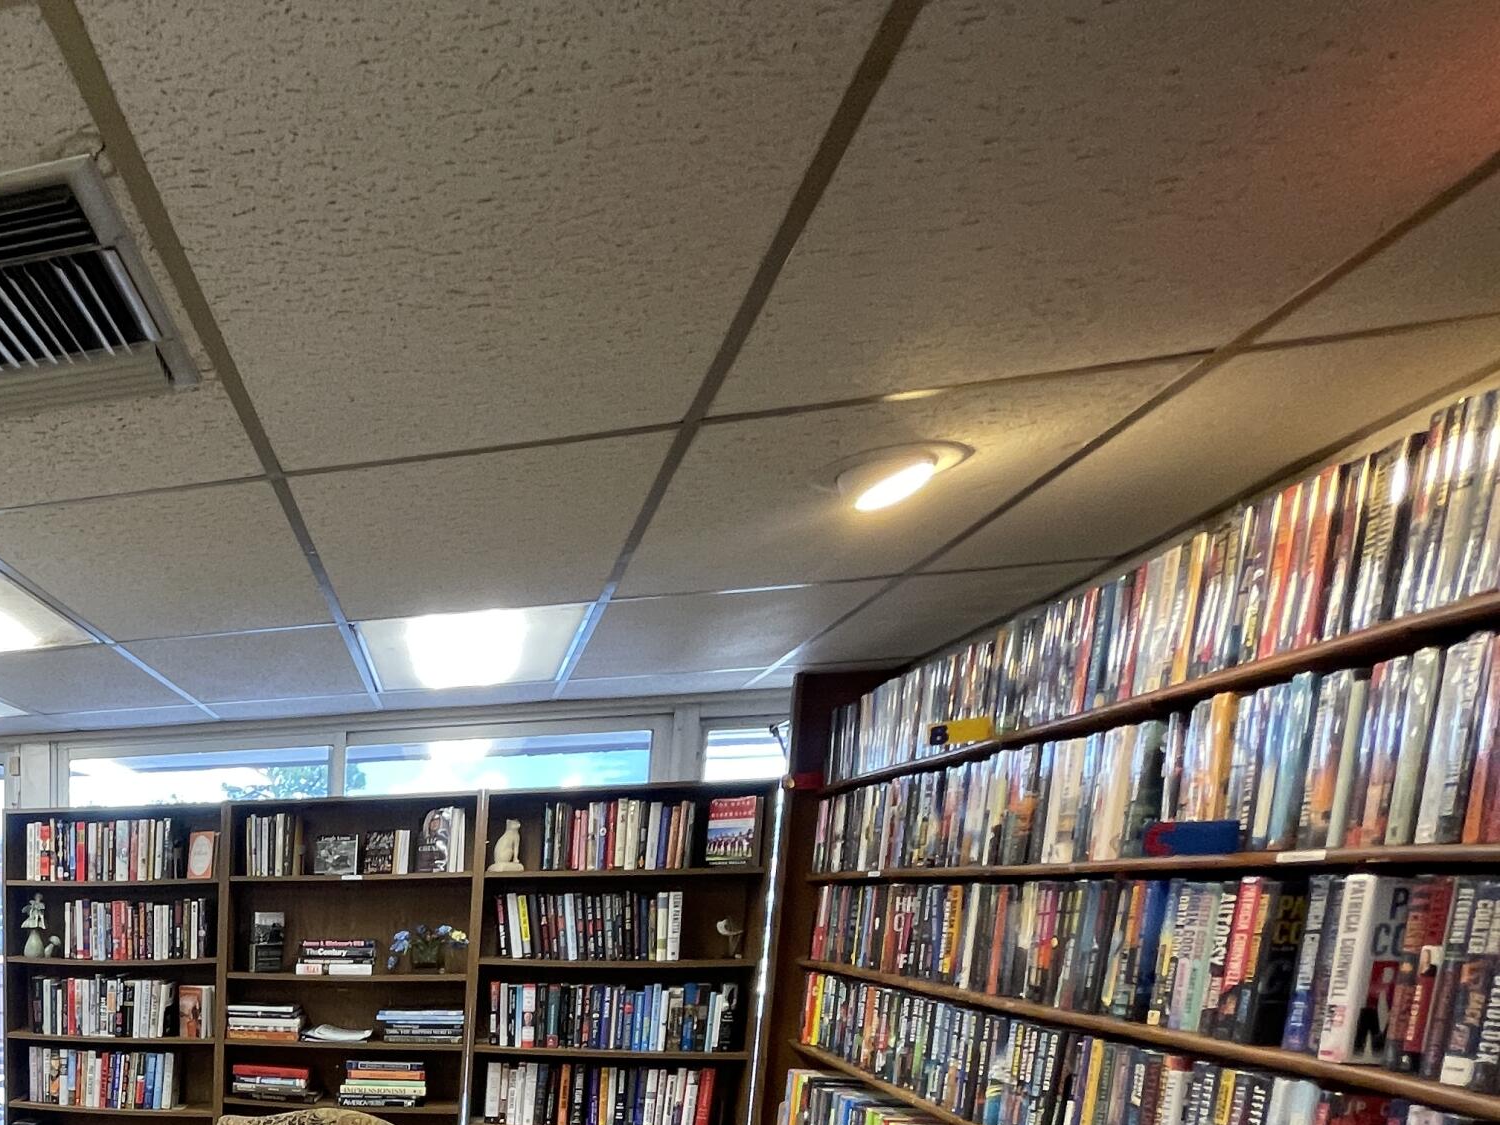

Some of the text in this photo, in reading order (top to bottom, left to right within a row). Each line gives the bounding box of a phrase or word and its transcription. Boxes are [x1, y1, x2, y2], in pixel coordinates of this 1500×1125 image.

[929, 725, 949, 746] B
[1144, 822, 1176, 855] C
[317, 948, 348, 957] Century
[1179, 929, 1195, 960] COOK
[1208, 891, 1237, 966] AUTOPSY
[1225, 883, 1257, 987] PATRICIA CORNWELL
[1331, 878, 1366, 1000] PATRICIA CORNWELL
[1467, 897, 1493, 956] COULTER
[1042, 1033, 1057, 1090] CLIVE CUSSLER
[1196, 1072, 1215, 1122] JEFFERY
